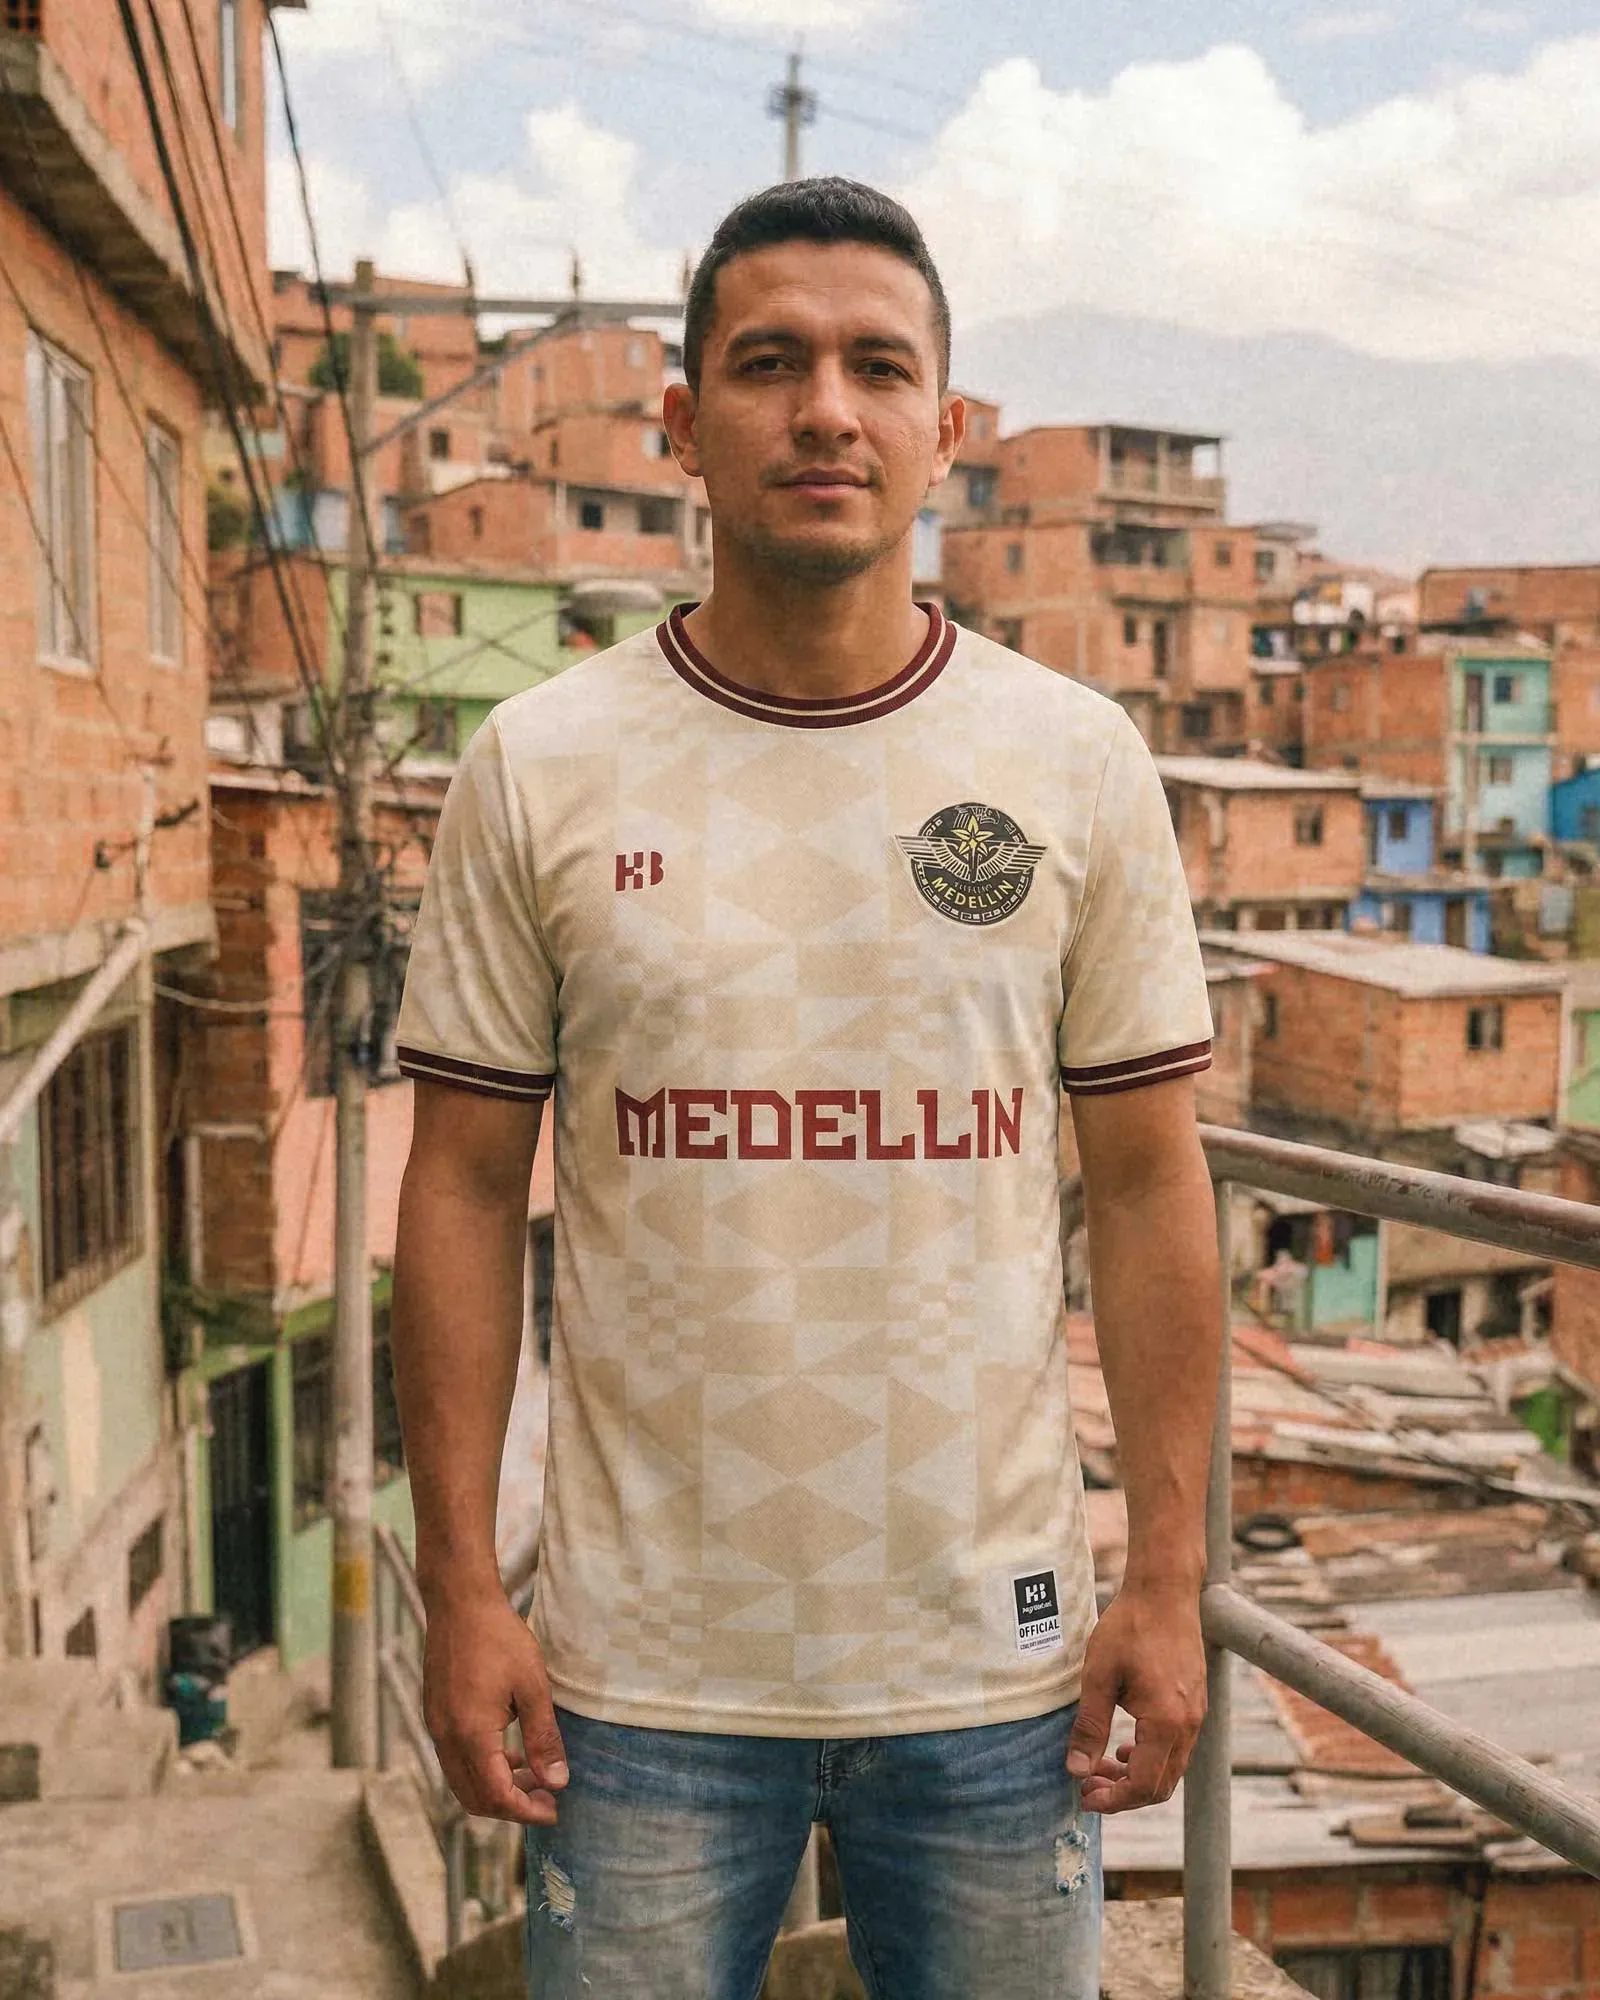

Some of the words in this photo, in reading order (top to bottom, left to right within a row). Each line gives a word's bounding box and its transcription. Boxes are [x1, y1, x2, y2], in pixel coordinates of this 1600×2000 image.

[931, 876, 1014, 909] MEDELLIN
[615, 1087, 1024, 1160] MEDELLIN
[1019, 1619, 1060, 1639] OFFICIAL
